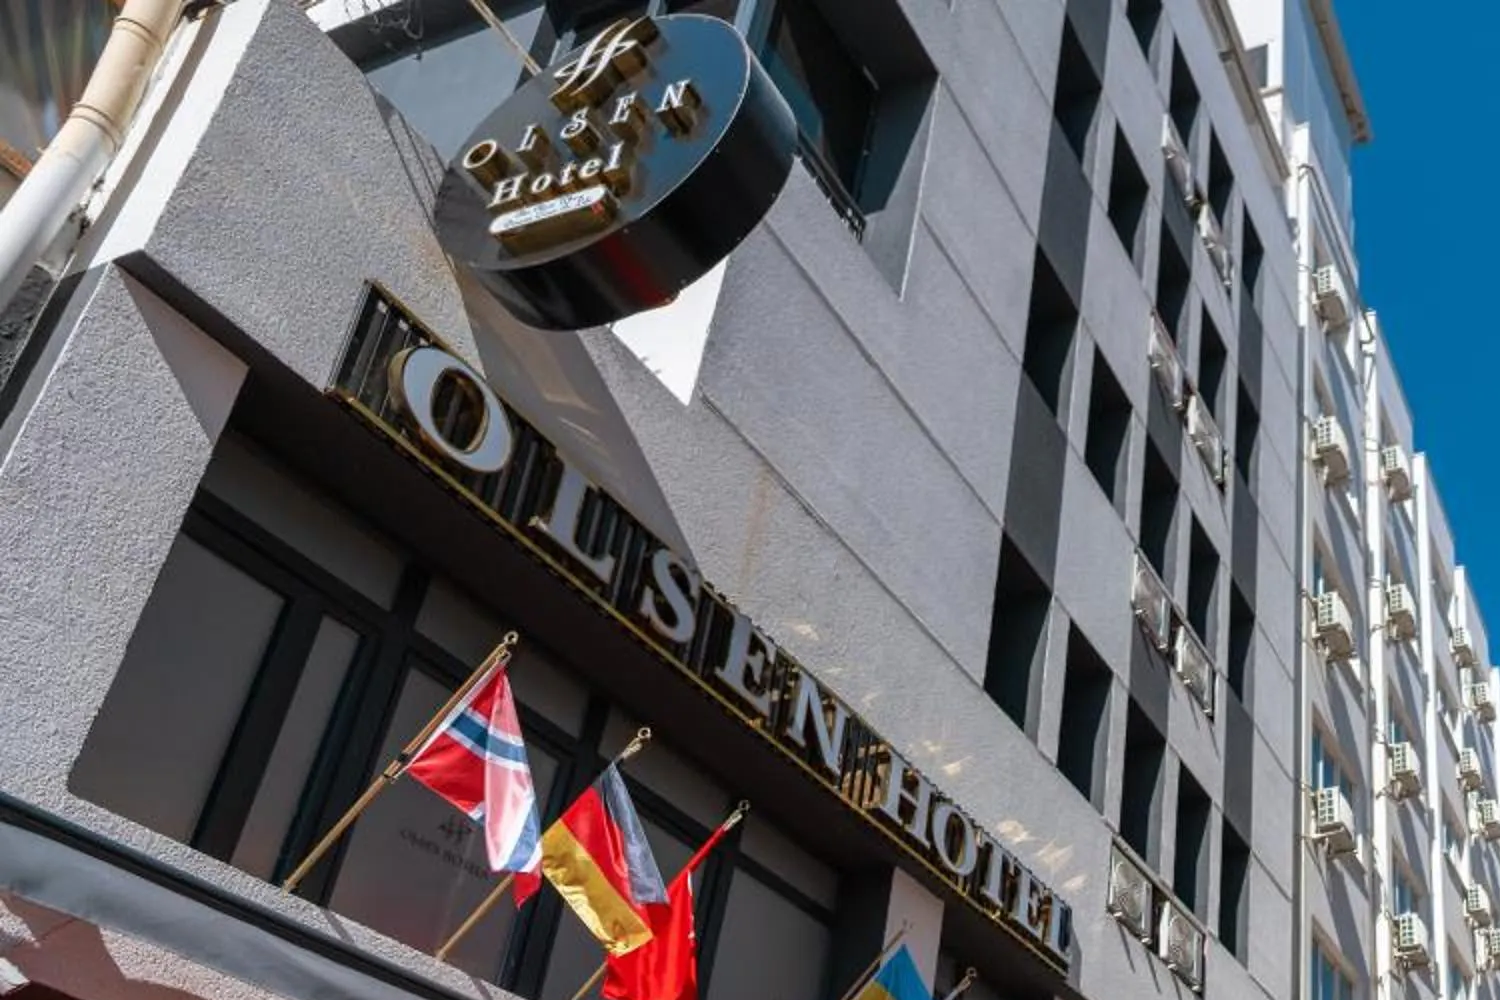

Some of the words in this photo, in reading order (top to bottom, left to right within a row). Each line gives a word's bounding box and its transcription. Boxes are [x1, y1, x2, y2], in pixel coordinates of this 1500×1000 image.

[462, 79, 692, 169] OLSEN
[485, 142, 623, 208] Hotel
[395, 346, 856, 778] OLSEN
[880, 752, 1074, 960] HOTEL
